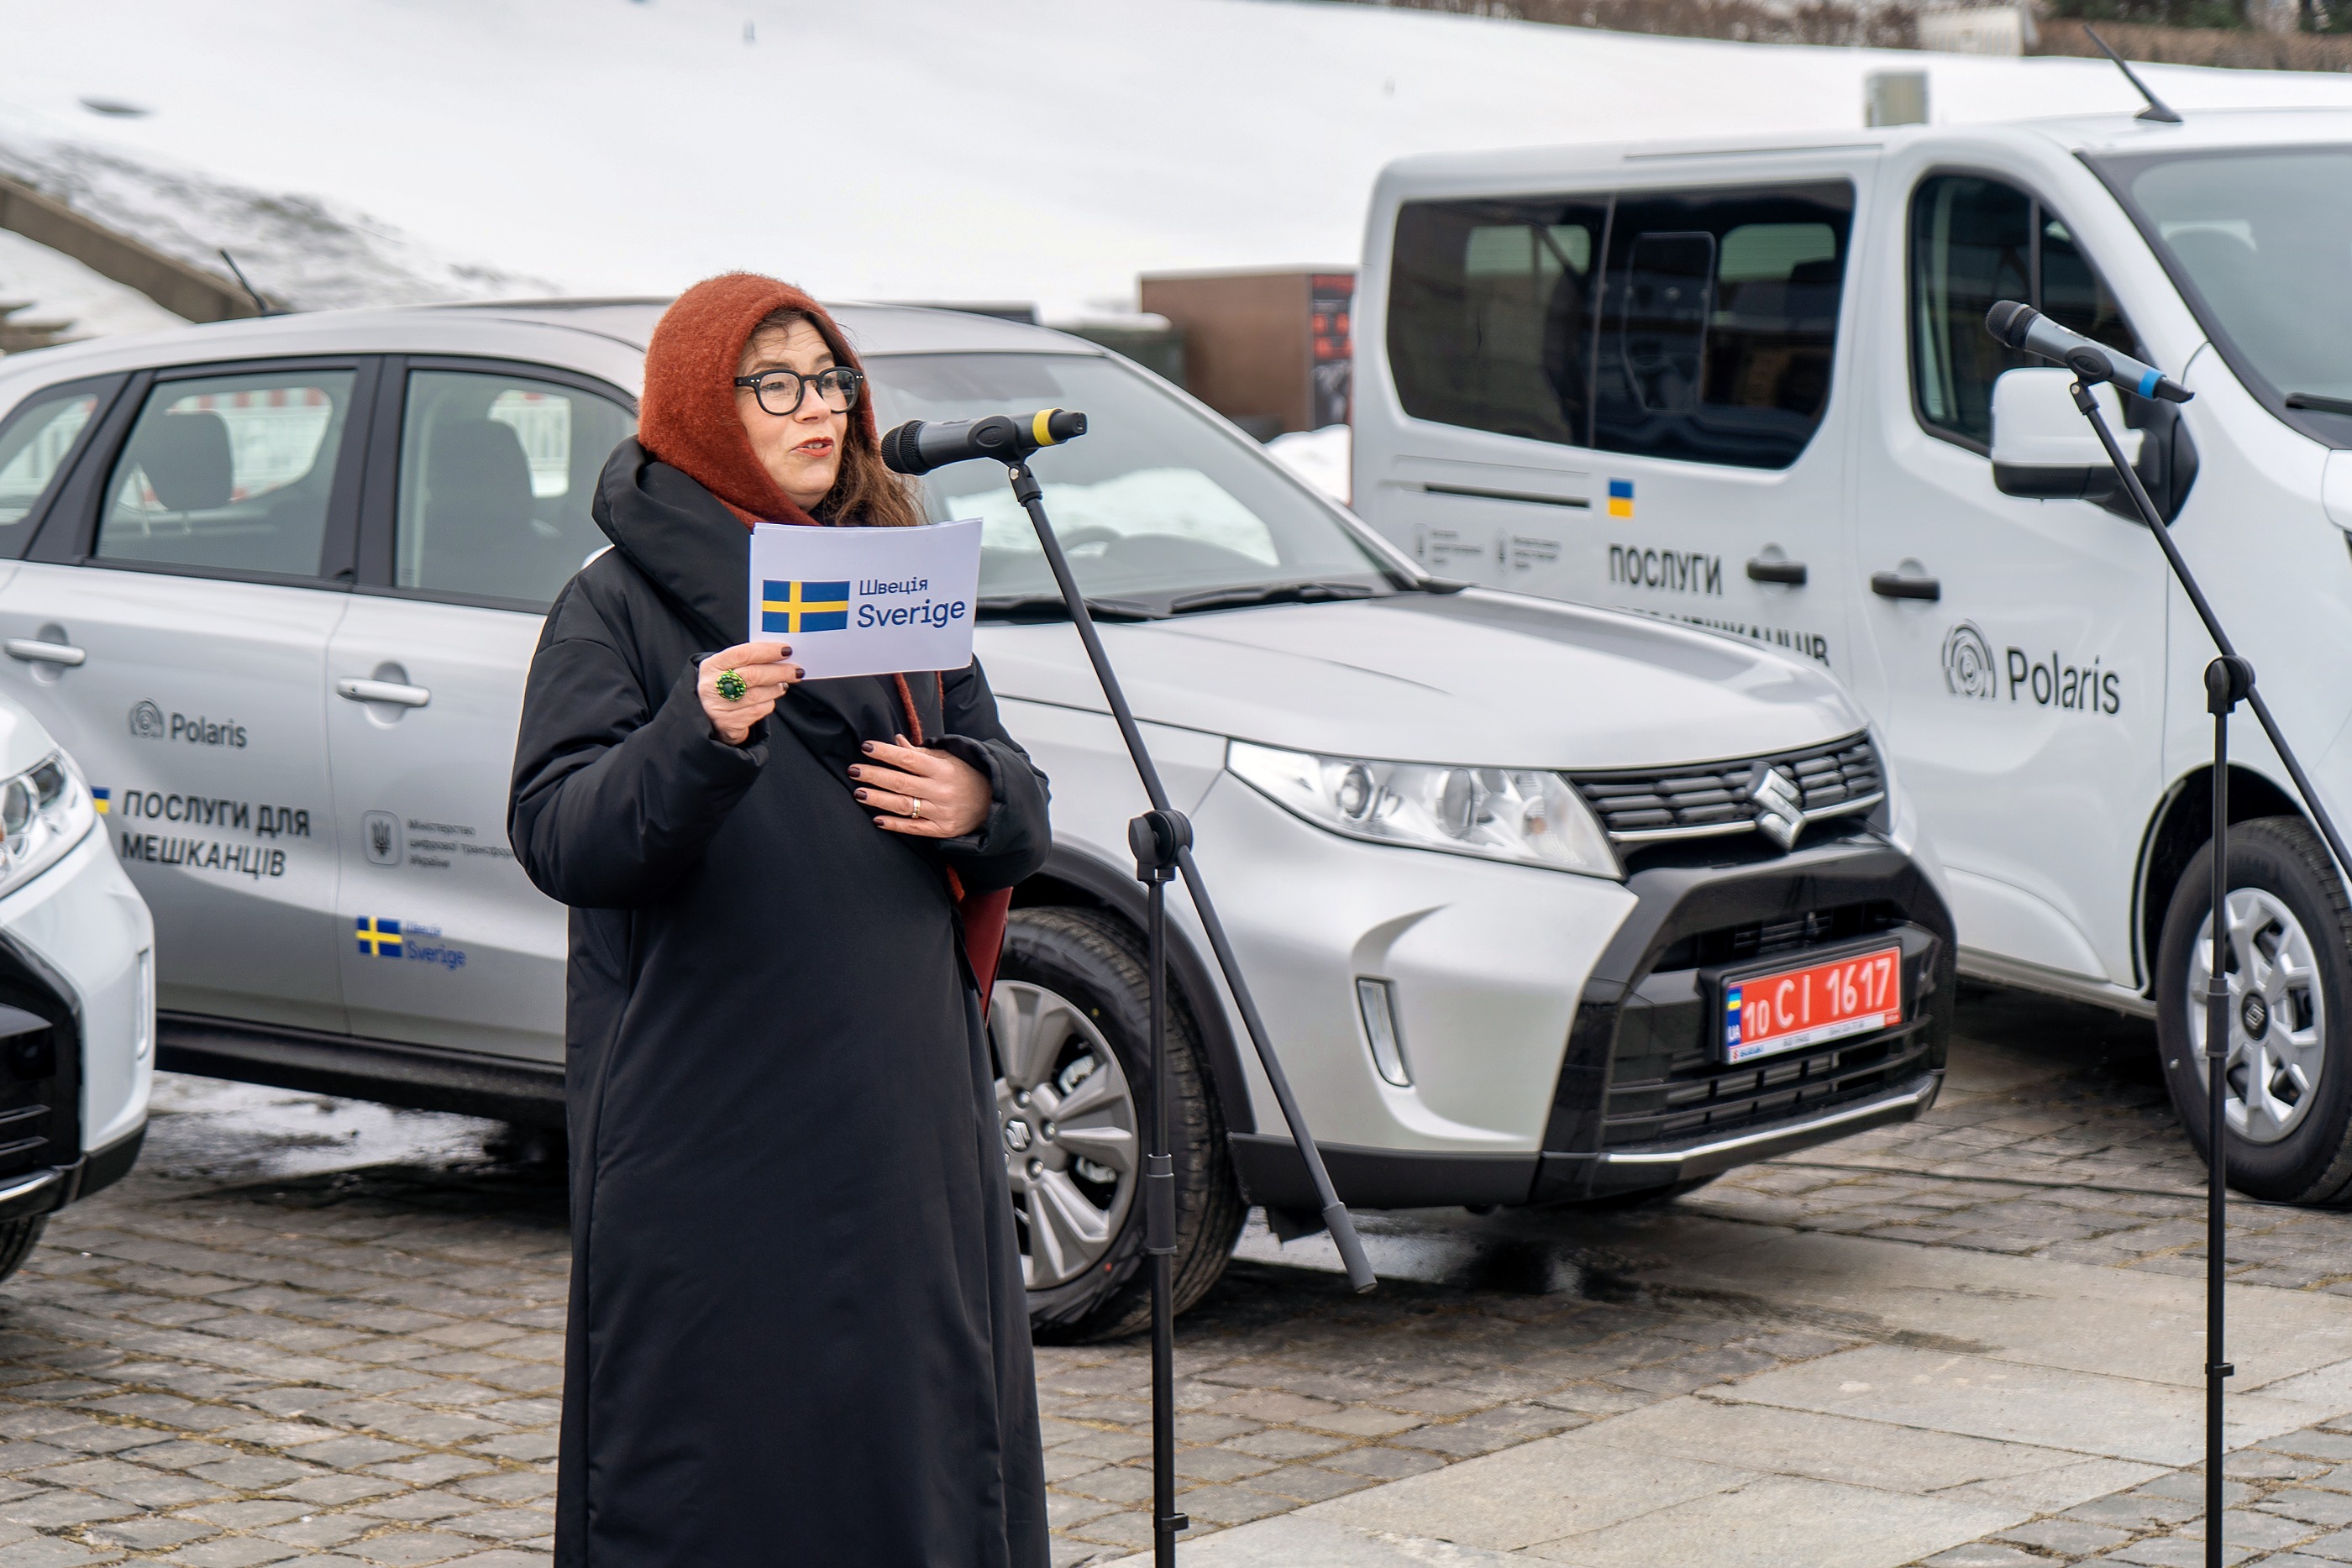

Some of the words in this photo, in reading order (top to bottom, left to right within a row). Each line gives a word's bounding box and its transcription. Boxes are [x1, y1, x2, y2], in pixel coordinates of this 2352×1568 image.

[859, 576, 928, 596] Швеція
[1609, 543, 1722, 595] ПОСЛУГИ
[857, 599, 966, 629] Sverige
[2007, 645, 2120, 715] Polaris
[171, 712, 248, 748] Polaris
[123, 789, 250, 830] ПОСЛУГИ
[256, 804, 312, 837] ДЛЯ
[121, 831, 286, 879] МЕШКАНЦІВ
[407, 941, 466, 969] Sverige
[1744, 999, 1770, 1039] 10
[1826, 957, 1891, 1016] 1617
[1728, 1024, 1741, 1042] UA
